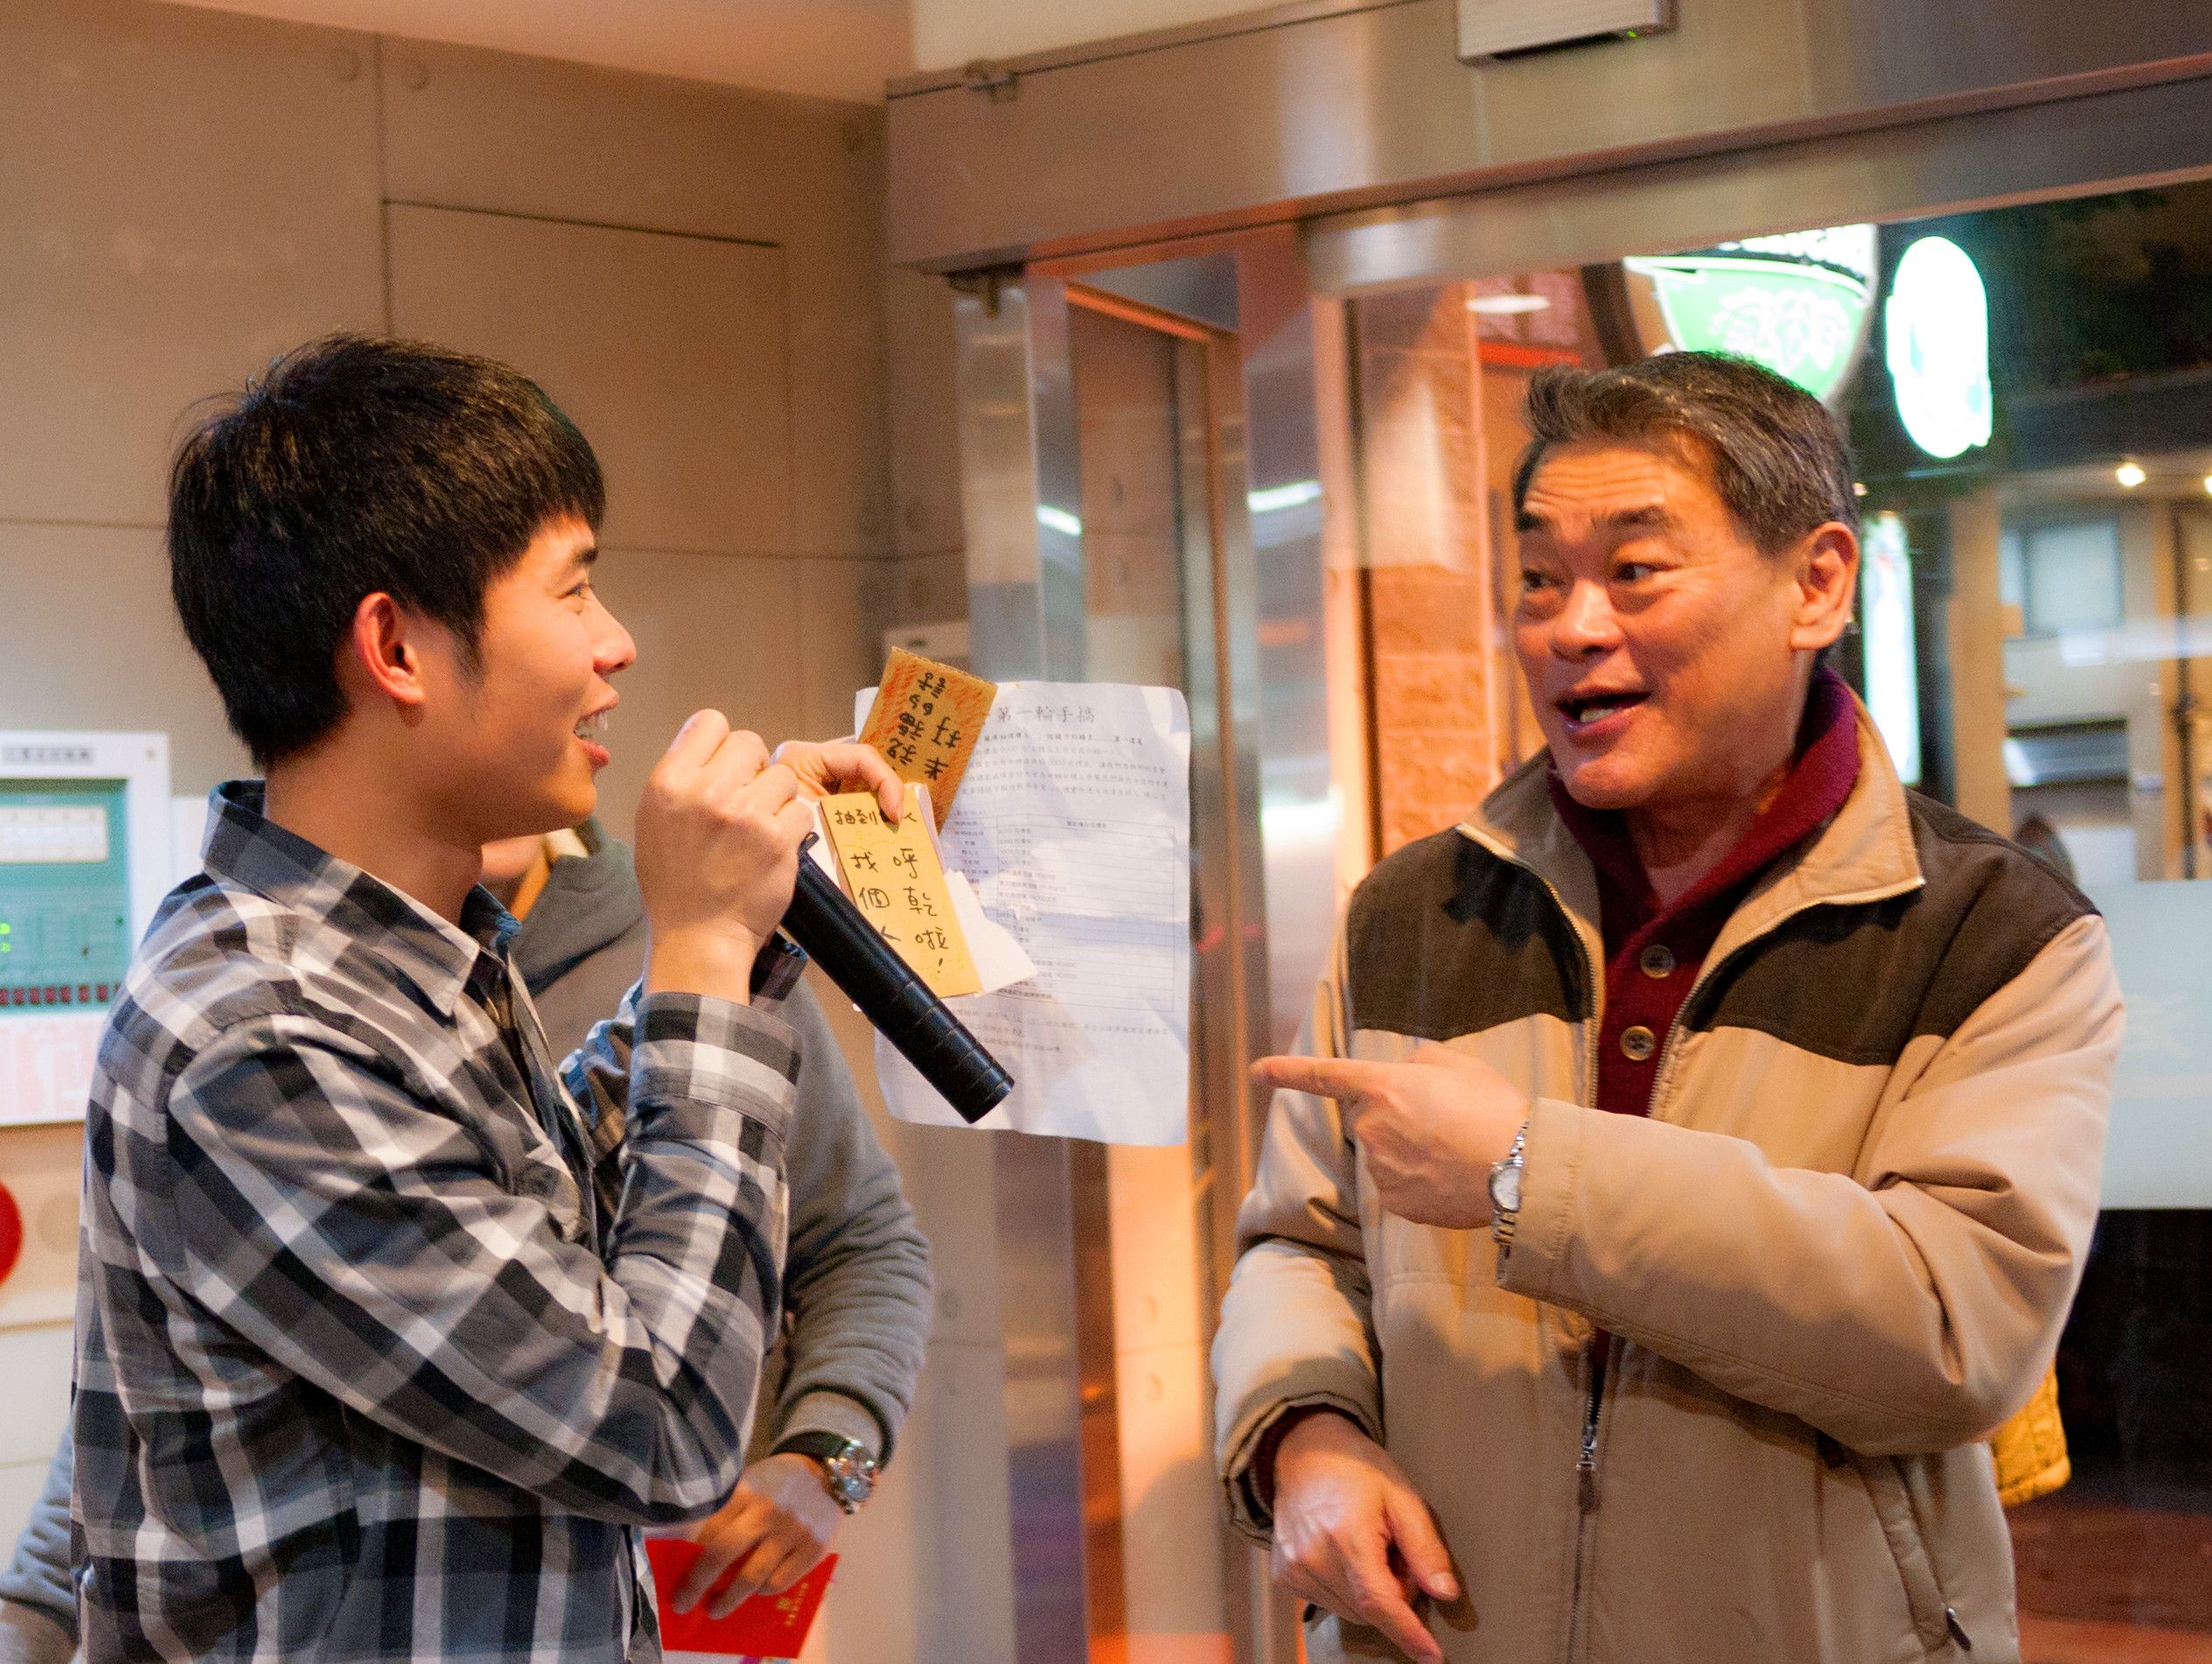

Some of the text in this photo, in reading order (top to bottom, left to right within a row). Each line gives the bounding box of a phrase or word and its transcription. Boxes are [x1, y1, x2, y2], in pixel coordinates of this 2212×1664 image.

[886, 671, 946, 772] 祝福的話
[834, 808, 918, 826] 抽到人
